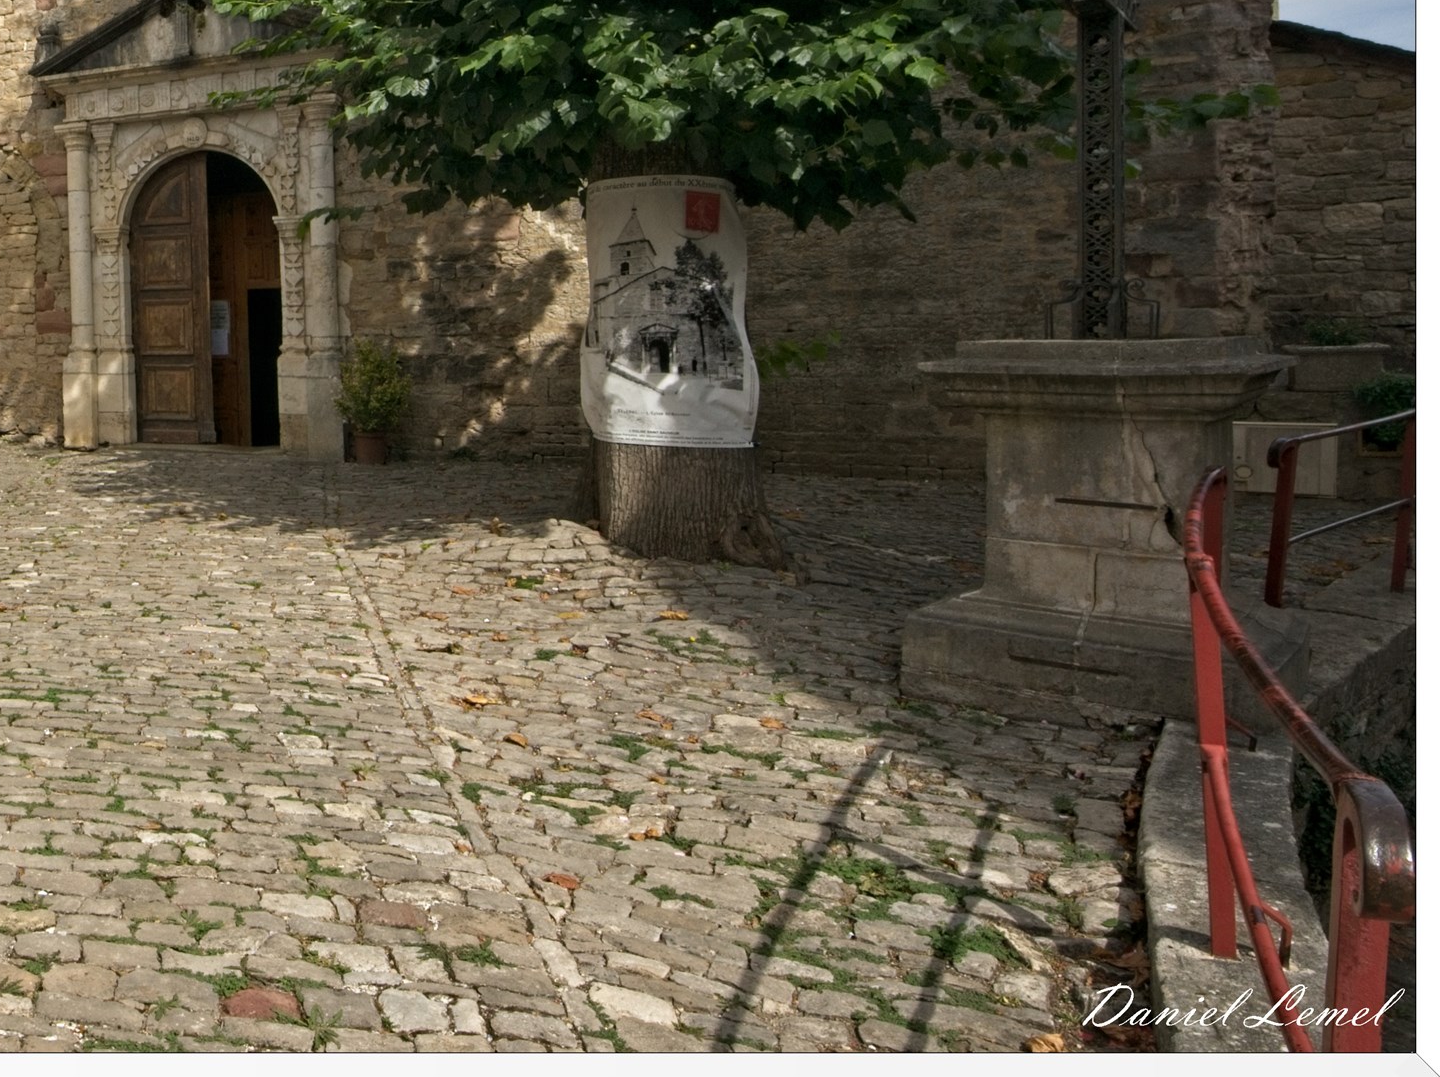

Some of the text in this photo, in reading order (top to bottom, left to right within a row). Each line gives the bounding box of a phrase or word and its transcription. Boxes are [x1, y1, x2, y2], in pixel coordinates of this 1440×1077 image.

[603, 180, 635, 191] caractère
[649, 177, 672, 187] début
[675, 178, 686, 187] du
